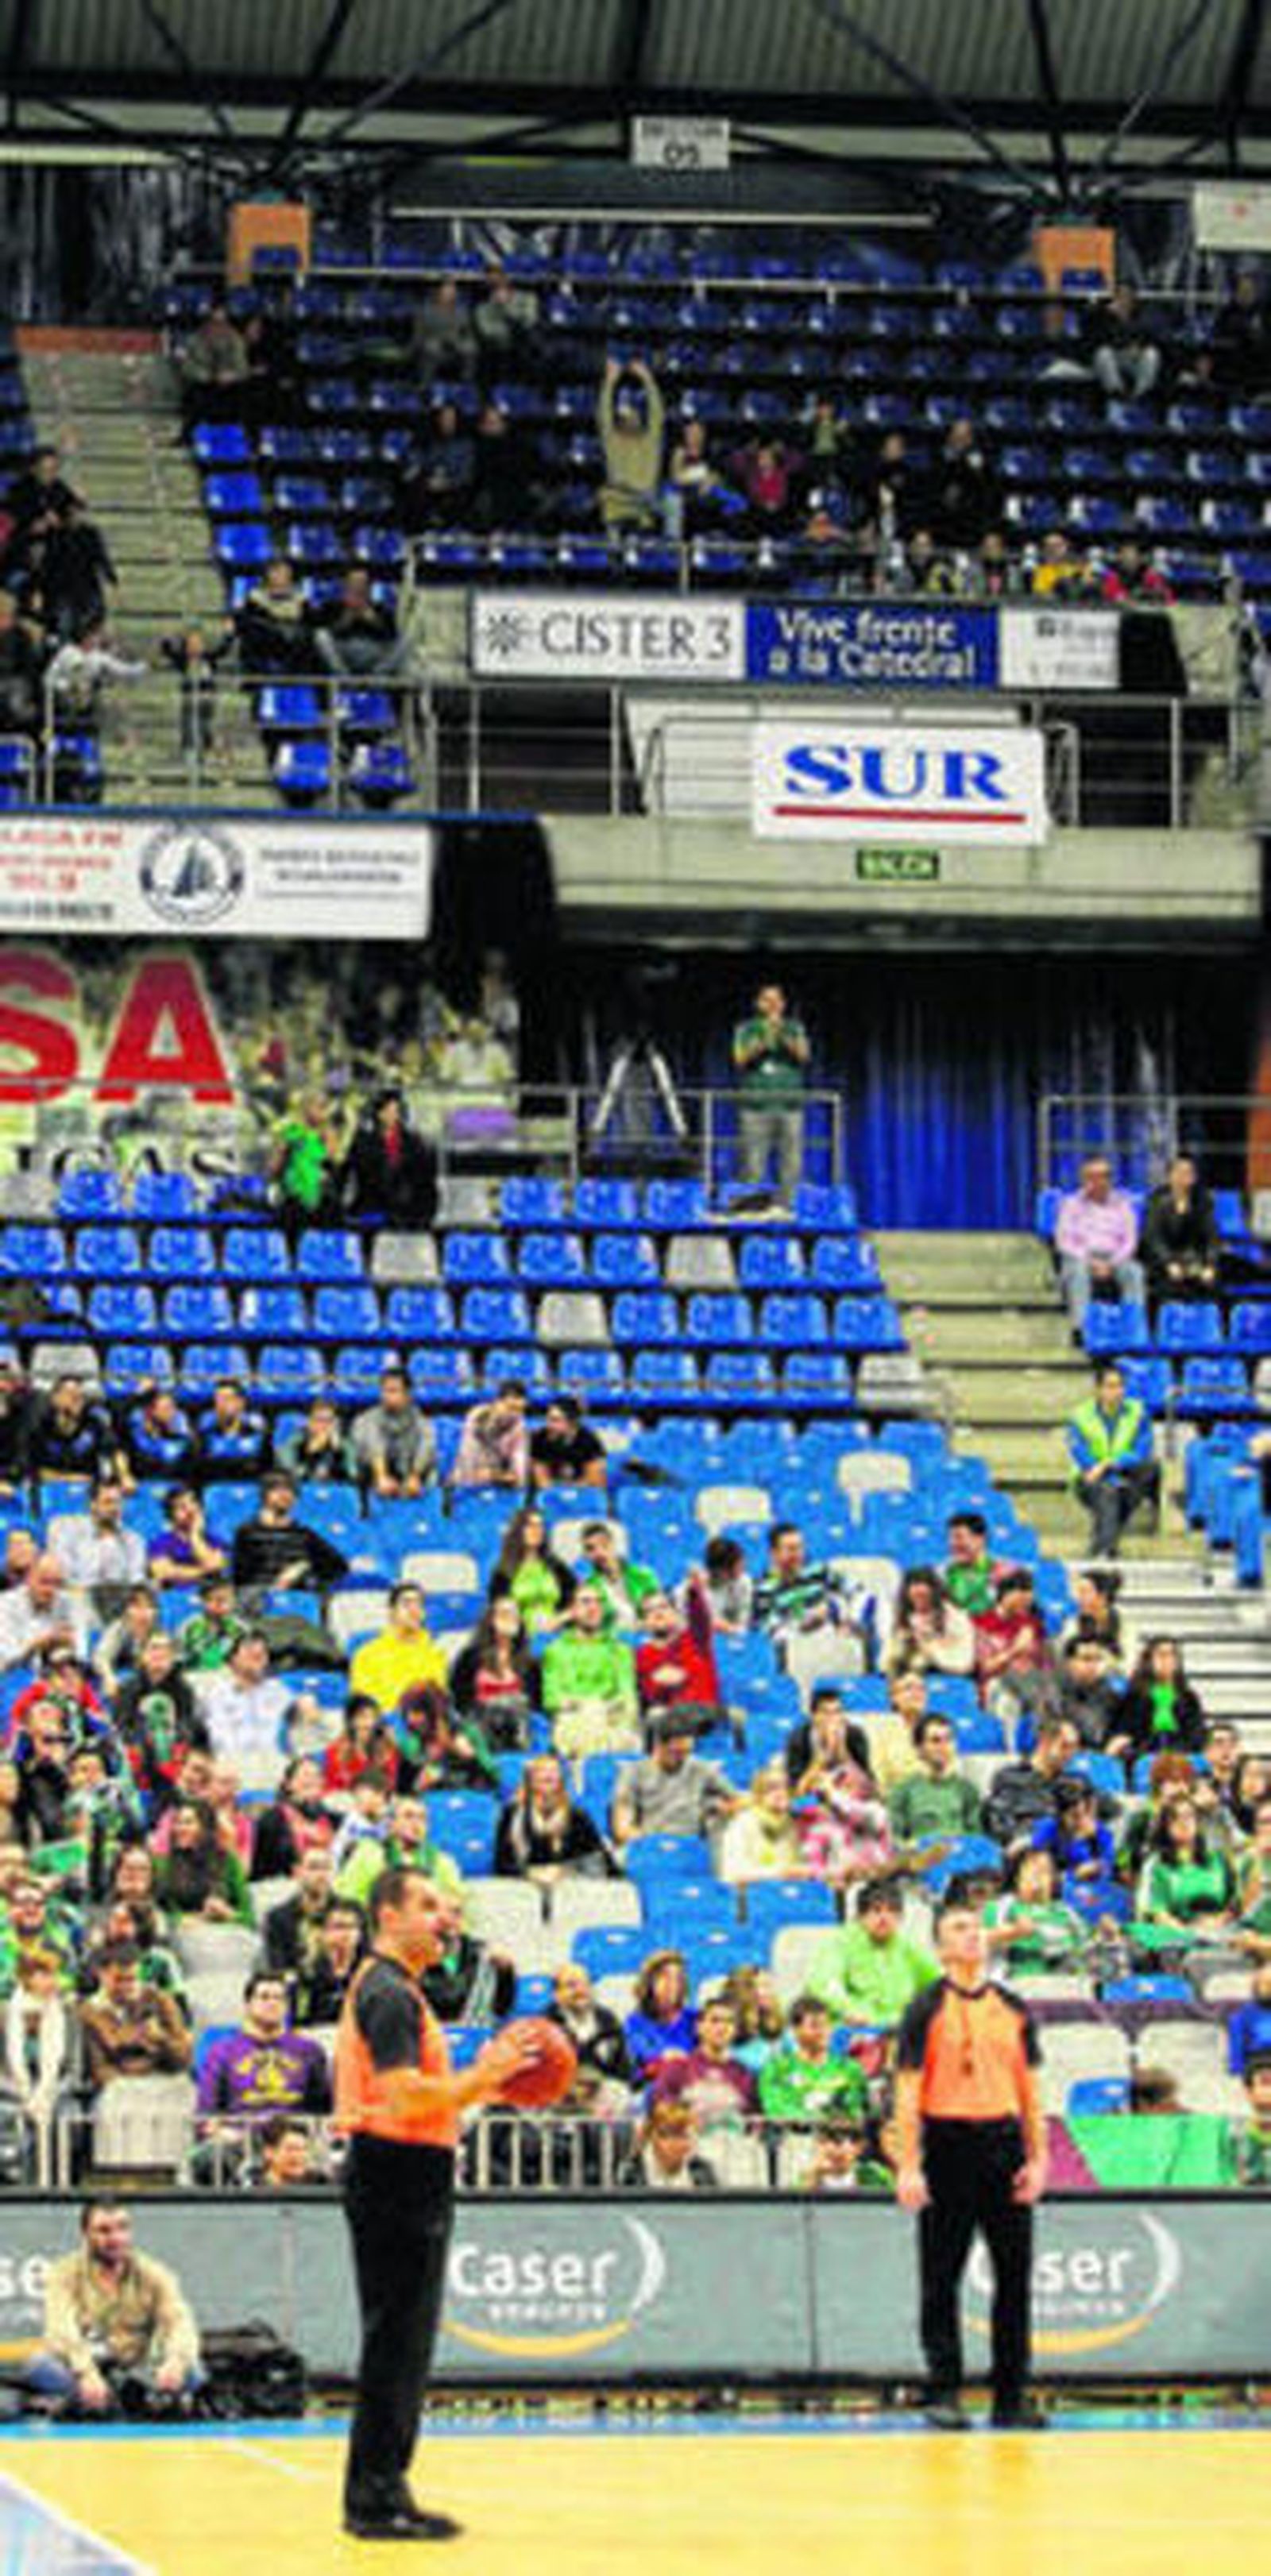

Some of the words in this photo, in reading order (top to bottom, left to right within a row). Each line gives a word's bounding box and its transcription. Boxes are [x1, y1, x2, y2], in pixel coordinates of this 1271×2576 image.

[540, 610, 696, 661] CISTER
[705, 616, 731, 660] 3
[775, 608, 848, 644] Vive
[856, 609, 956, 647] frente
[836, 640, 975, 679] Catedral
[782, 743, 1010, 801] SUR
[448, 2242, 618, 2297] Caser
[966, 2236, 1134, 2295] Cser
